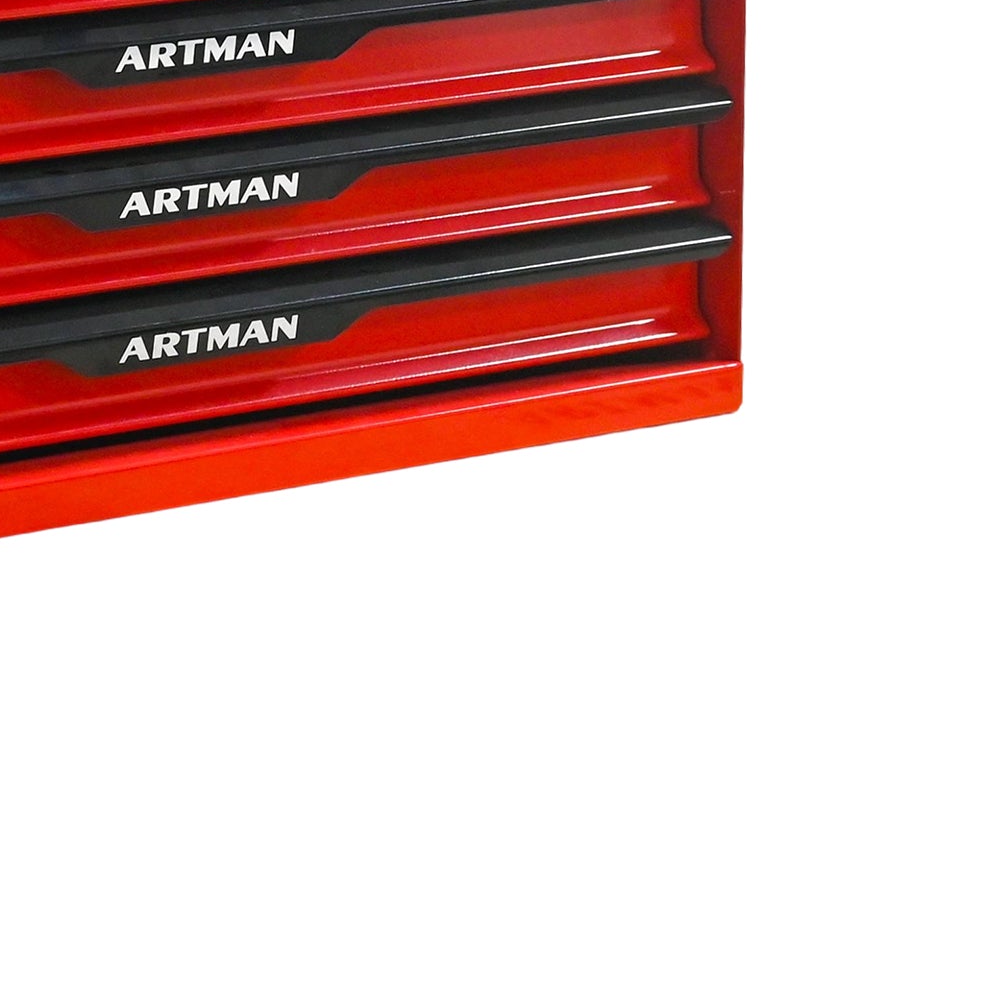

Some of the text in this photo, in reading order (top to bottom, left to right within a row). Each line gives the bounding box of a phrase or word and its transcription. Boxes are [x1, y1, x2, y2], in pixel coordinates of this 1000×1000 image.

[115, 28, 296, 73] ARTMAN
[119, 171, 300, 219] ARTMAN
[118, 314, 299, 364] ARTMAN
